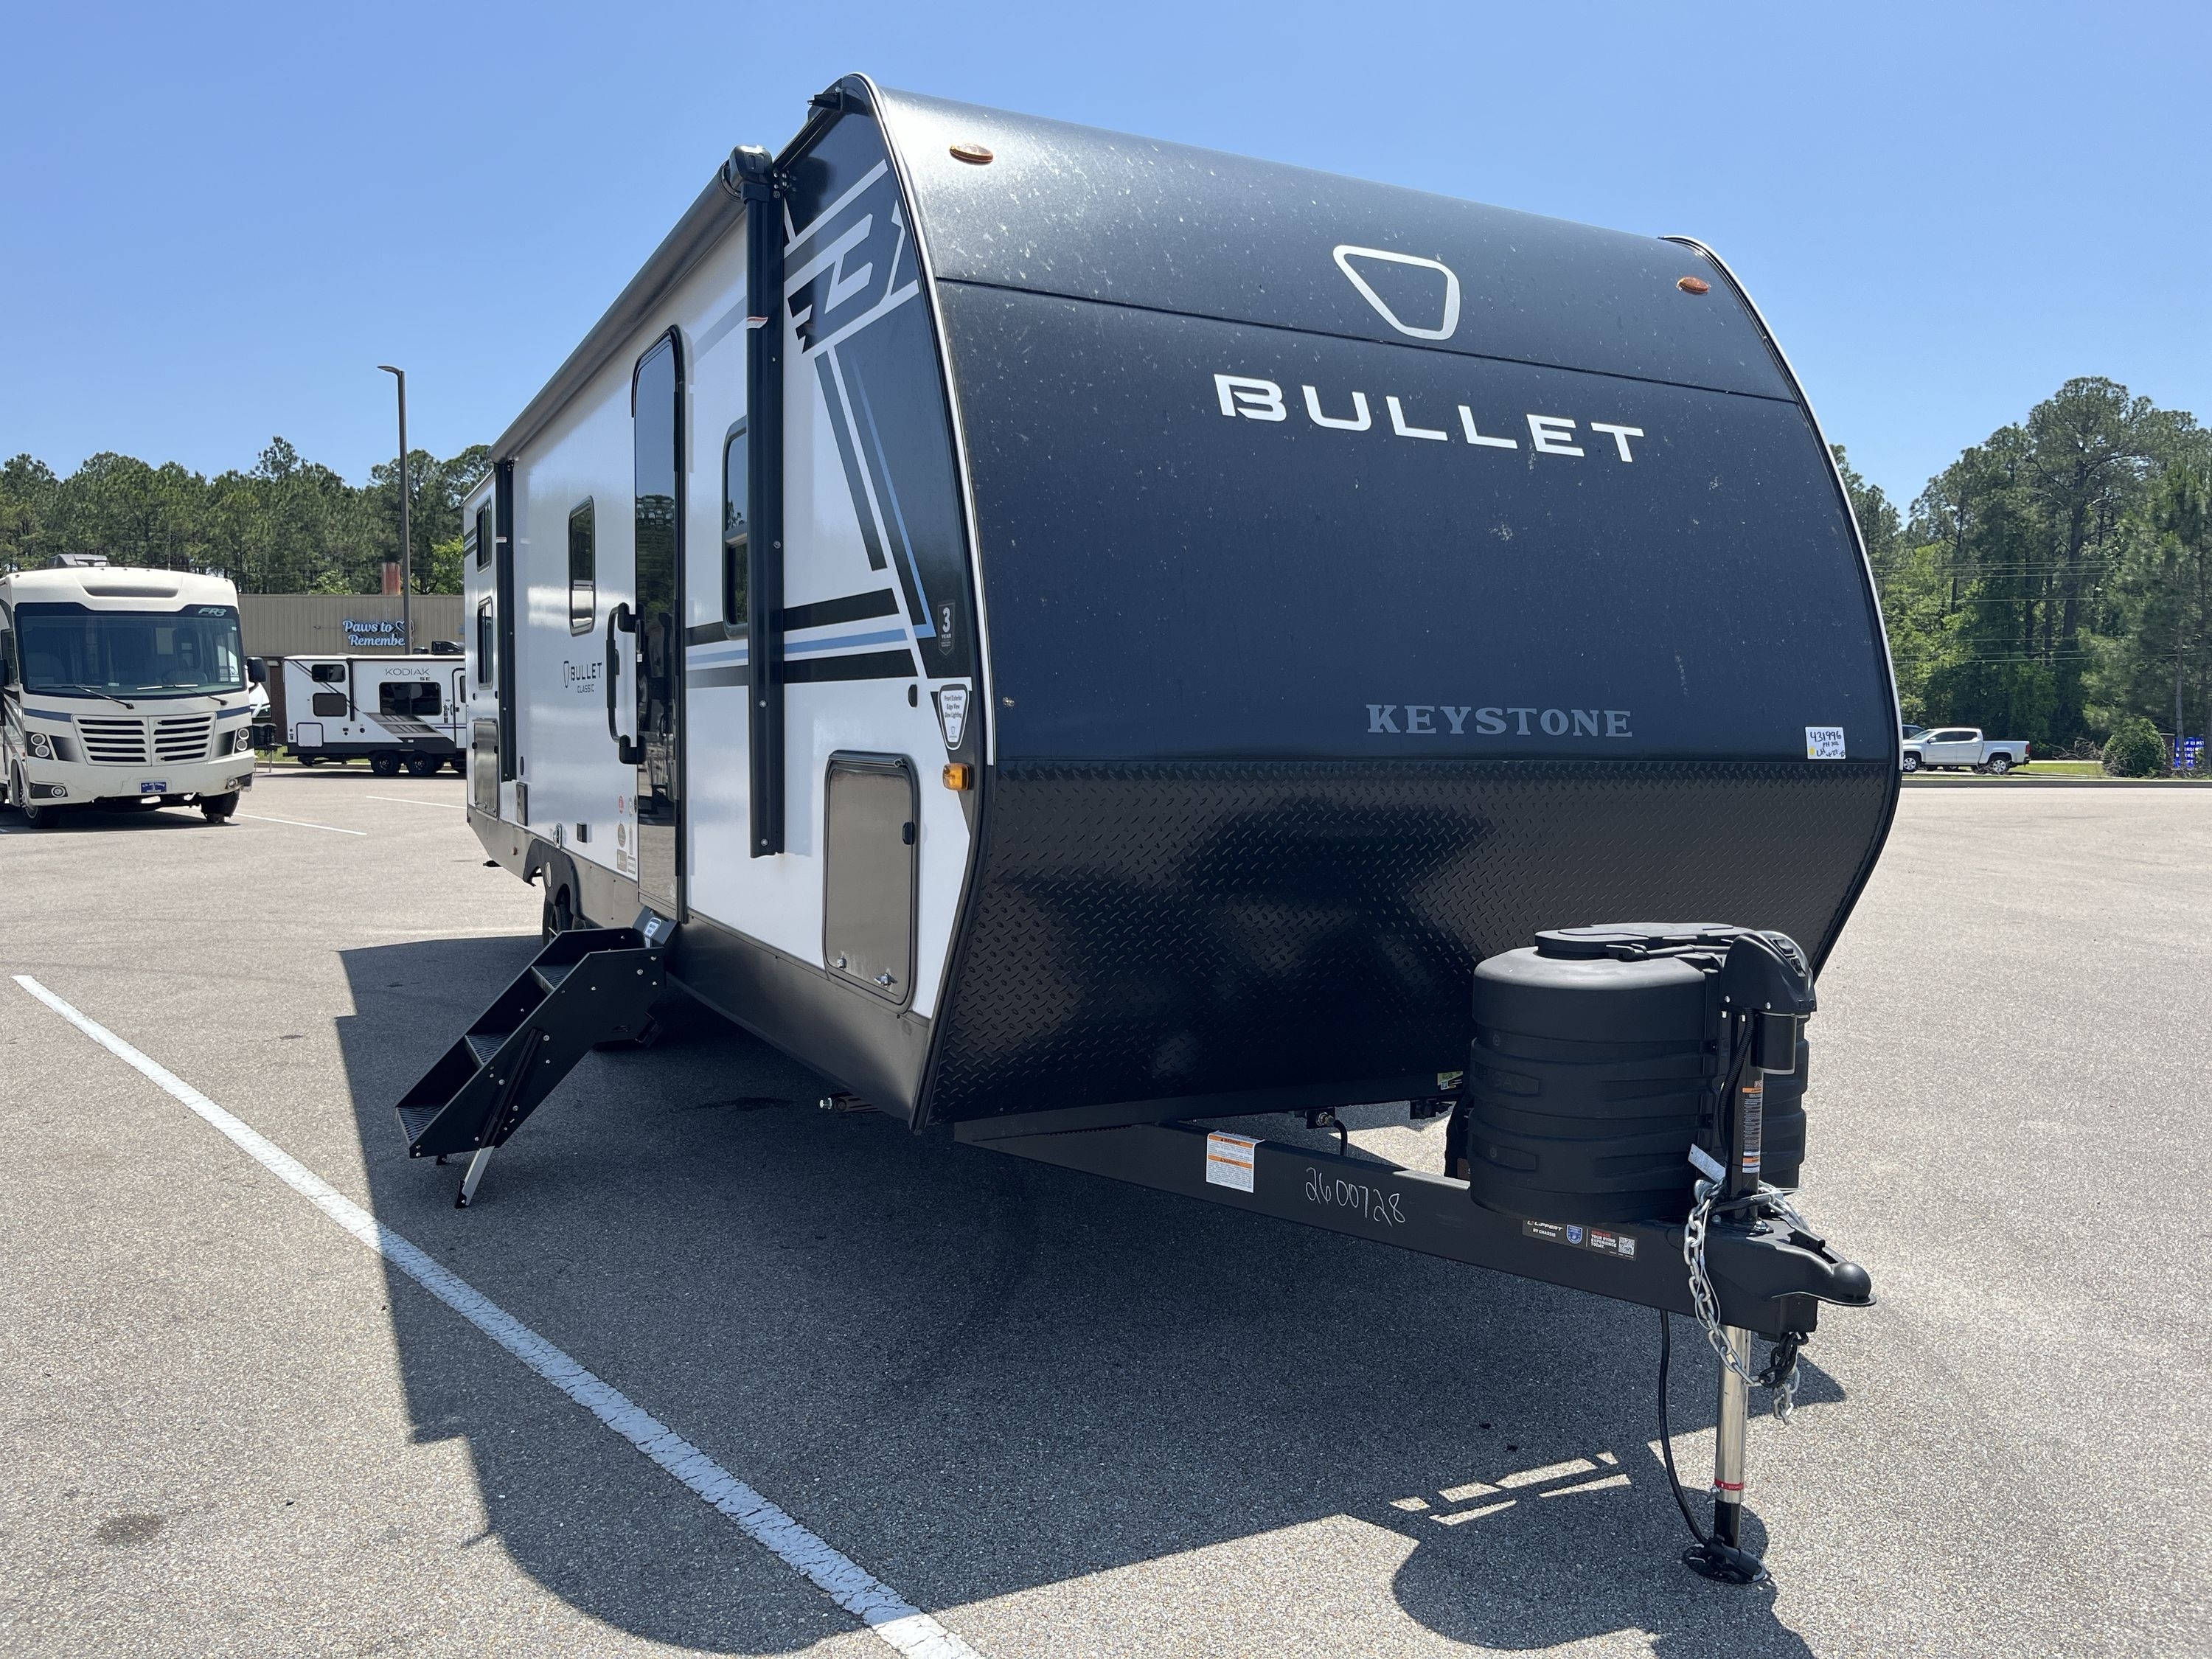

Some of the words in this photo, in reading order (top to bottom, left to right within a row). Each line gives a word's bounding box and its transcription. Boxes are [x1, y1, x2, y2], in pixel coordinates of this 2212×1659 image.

[1214, 374, 1644, 463] BULLET
[198, 608, 226, 616] FR3
[942, 607, 951, 633] 3
[342, 620, 378, 632] Paws
[380, 622, 394, 633] to
[348, 633, 414, 646] Remembe
[385, 668, 430, 676] KODIAK
[571, 662, 602, 681] BULLET
[577, 684, 594, 693] CLASSIC
[1366, 704, 1632, 737] KEYSTONE
[1809, 730, 1842, 742] 431996
[1306, 1167, 1406, 1227] 2600728
[1534, 1221, 1564, 1231] LIPPERT
[1538, 1229, 1557, 1237] CHASSIS
[1590, 1239, 1617, 1248] EXPERIENCE
